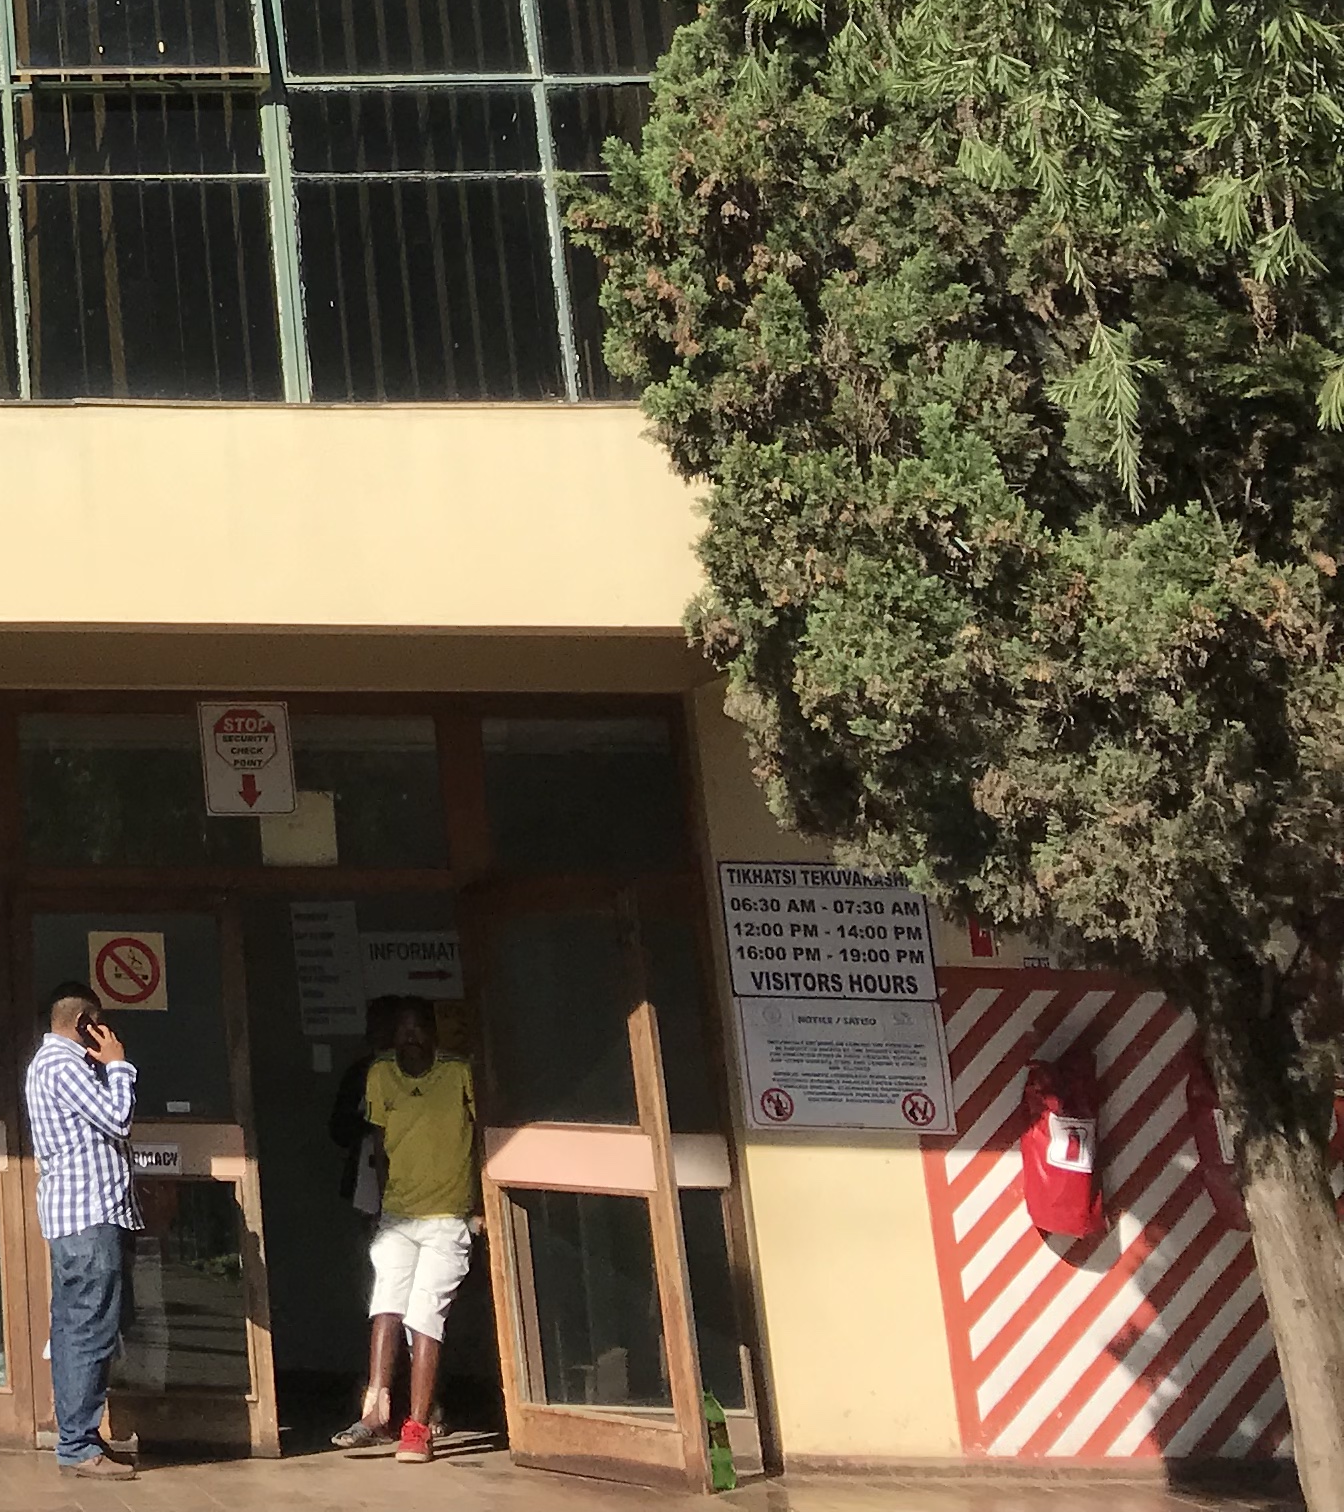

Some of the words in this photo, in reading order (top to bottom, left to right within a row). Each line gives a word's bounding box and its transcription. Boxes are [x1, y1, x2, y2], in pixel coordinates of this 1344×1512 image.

[223, 717, 268, 732] STOP
[222, 734, 270, 743] SECURITY
[230, 747, 263, 755] CHECK
[233, 759, 263, 767] POINT
[727, 868, 796, 885] TIKHATSI
[731, 897, 780, 912] 06:30
[787, 899, 816, 913] AM
[833, 900, 884, 915] 07:30
[891, 901, 920, 916] AM
[733, 922, 783, 937] 12:00
[790, 923, 818, 938] PM
[837, 925, 887, 940] 14:00
[894, 926, 922, 941] PM
[369, 942, 456, 961] INFORMAT
[736, 945, 786, 961] 16:00
[793, 947, 821, 961] PM
[839, 948, 889, 963] 19:00
[897, 949, 925, 964] PM
[751, 971, 843, 992] VISITORS
[849, 974, 918, 994] HOURS
[798, 1016, 833, 1024] NOTICE
